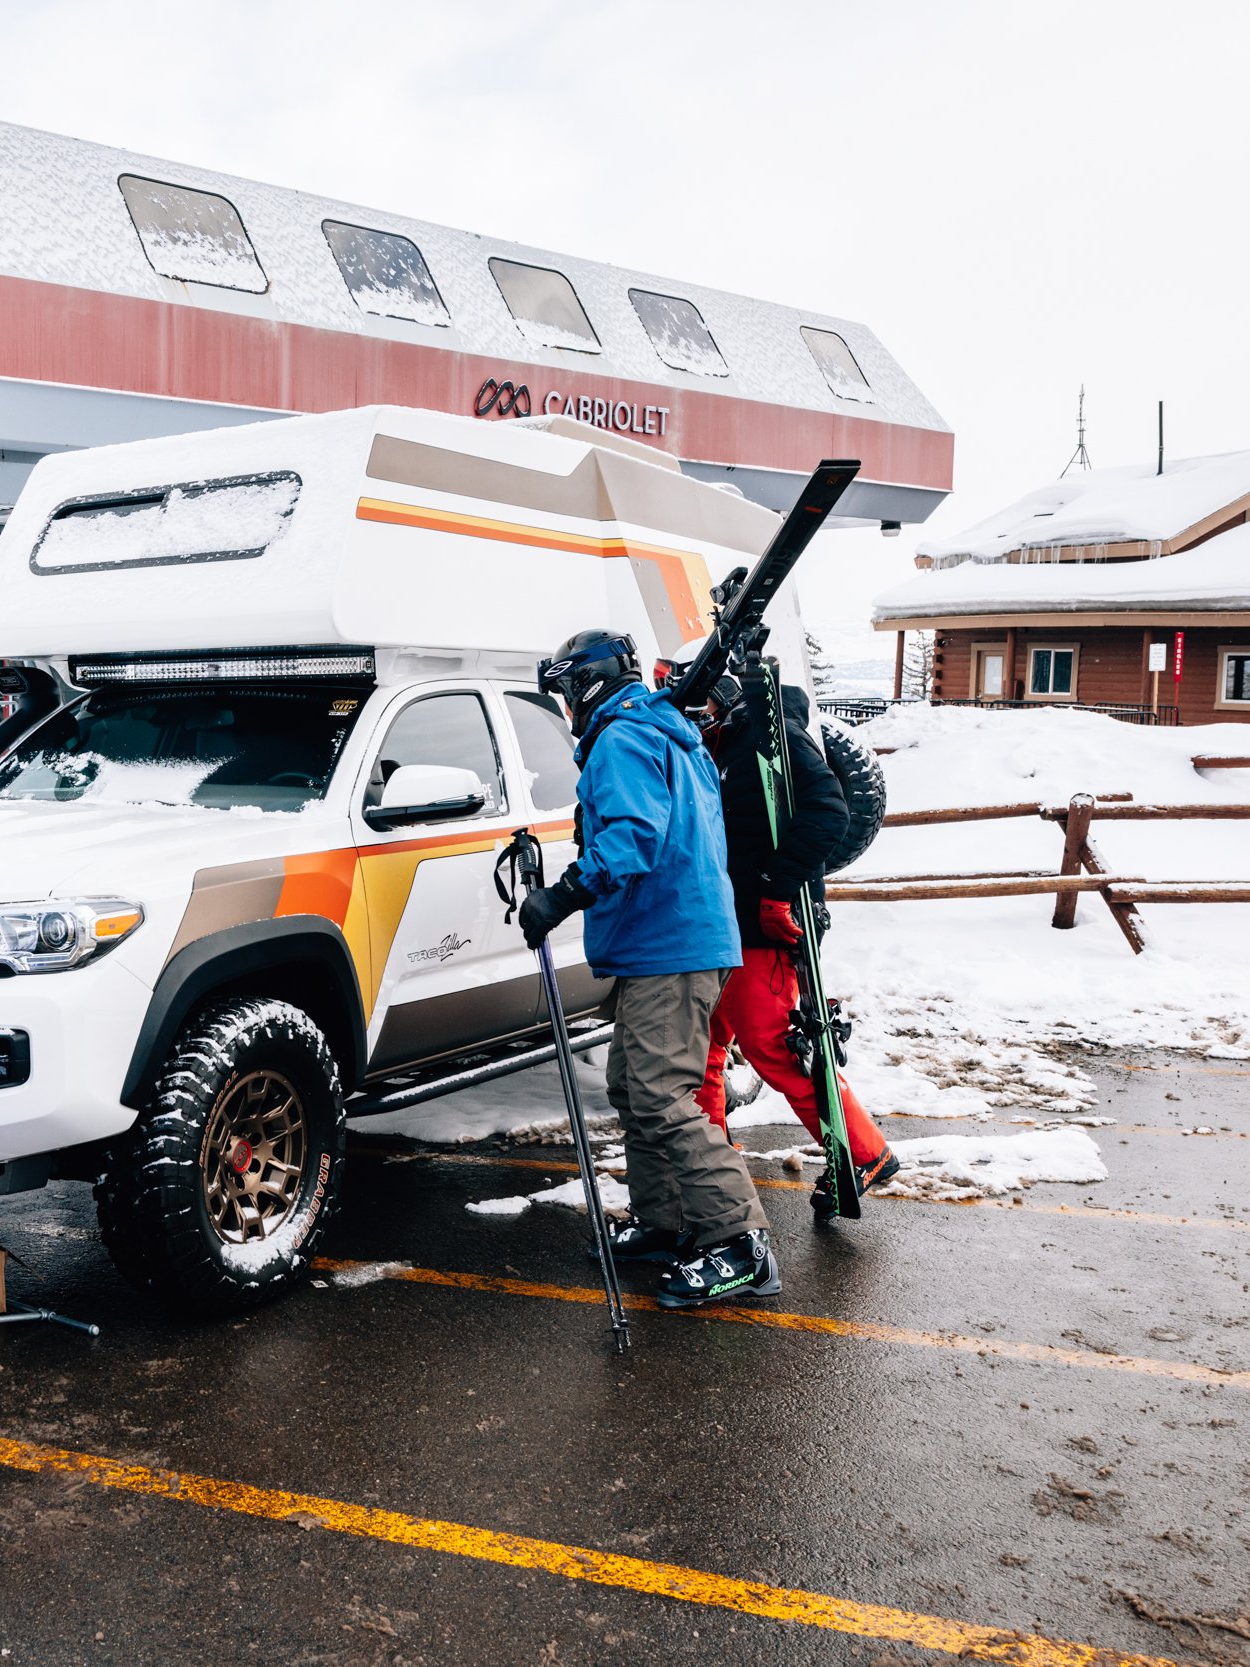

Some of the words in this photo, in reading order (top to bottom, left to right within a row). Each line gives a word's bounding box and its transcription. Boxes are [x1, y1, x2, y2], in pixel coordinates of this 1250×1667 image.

[544, 391, 670, 436] CABRIOLET
[292, 1152, 331, 1250] GRABBER
[708, 1272, 754, 1297] NORDICA
